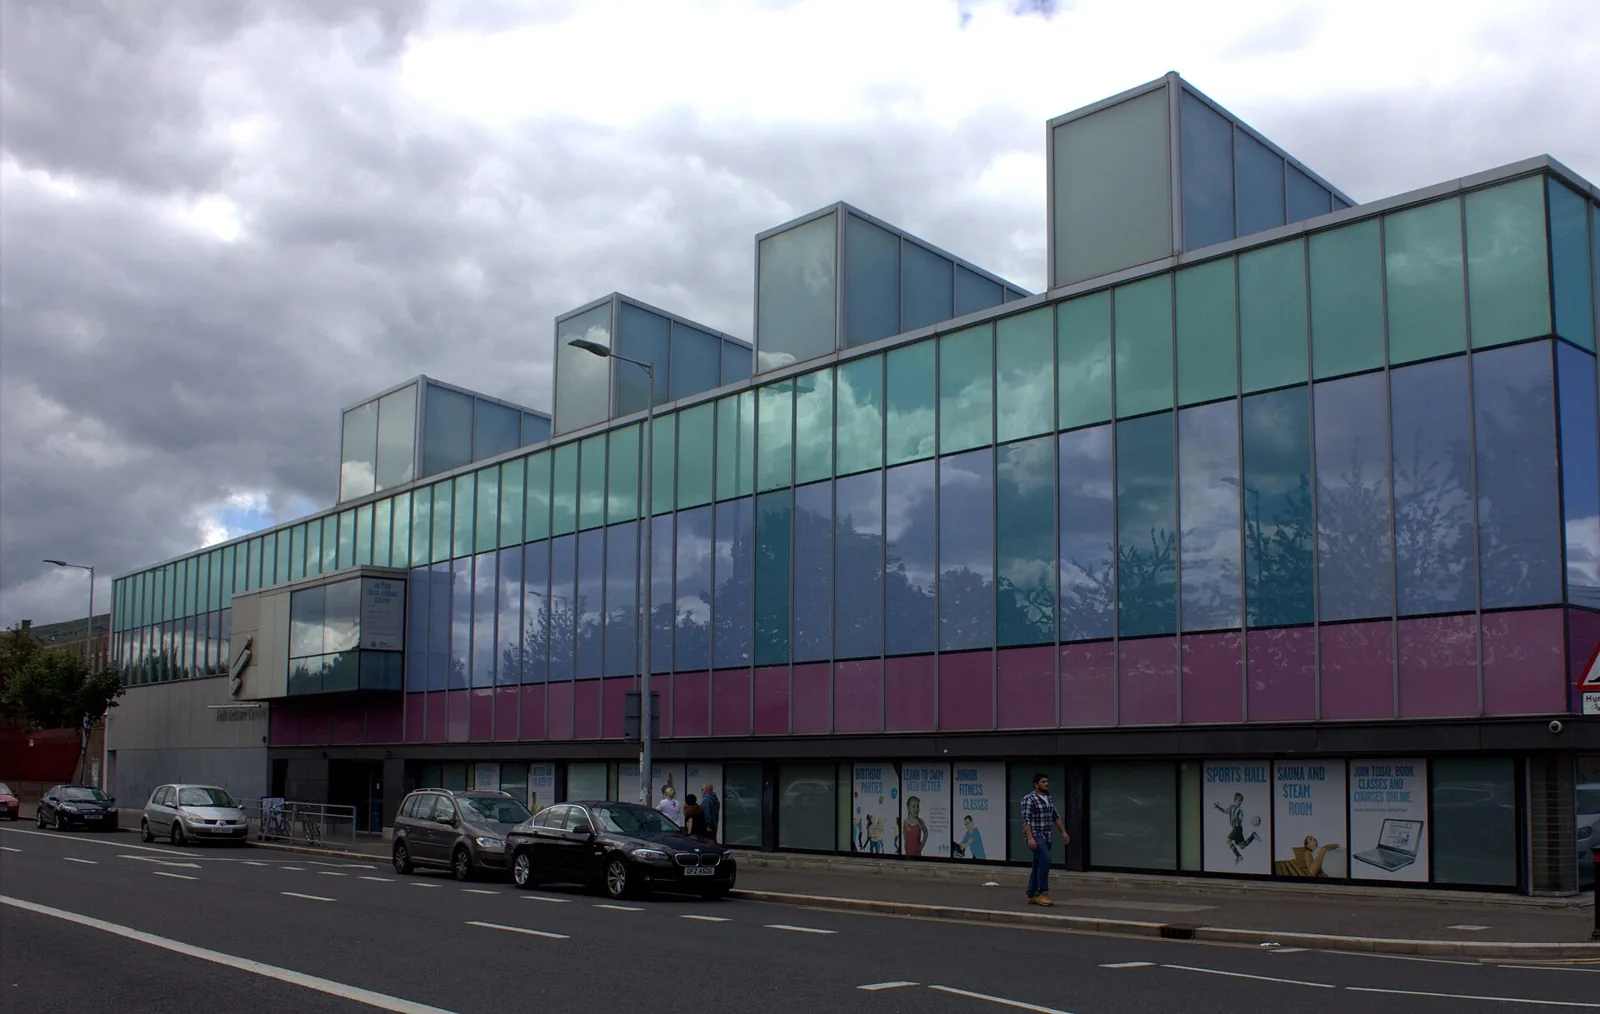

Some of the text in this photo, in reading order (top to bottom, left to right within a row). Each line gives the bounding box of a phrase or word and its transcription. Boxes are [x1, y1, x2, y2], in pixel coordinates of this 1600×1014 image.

[904, 768, 943, 780] LEARN TO SWIM
[1206, 766, 1267, 783] SPORTS HALL
[1277, 766, 1325, 781] SAUNA AND
[1395, 765, 1415, 777] BOOK
[861, 781, 884, 794] PARTIES
[921, 781, 941, 792] BETTER
[959, 783, 984, 796] FITNESS
[1358, 778, 1404, 790] CLASSES AND
[1283, 783, 1311, 799] STEAM
[1354, 791, 1384, 802] COURSES
[963, 798, 989, 811] CLASSES
[1289, 801, 1313, 816] ROOM
